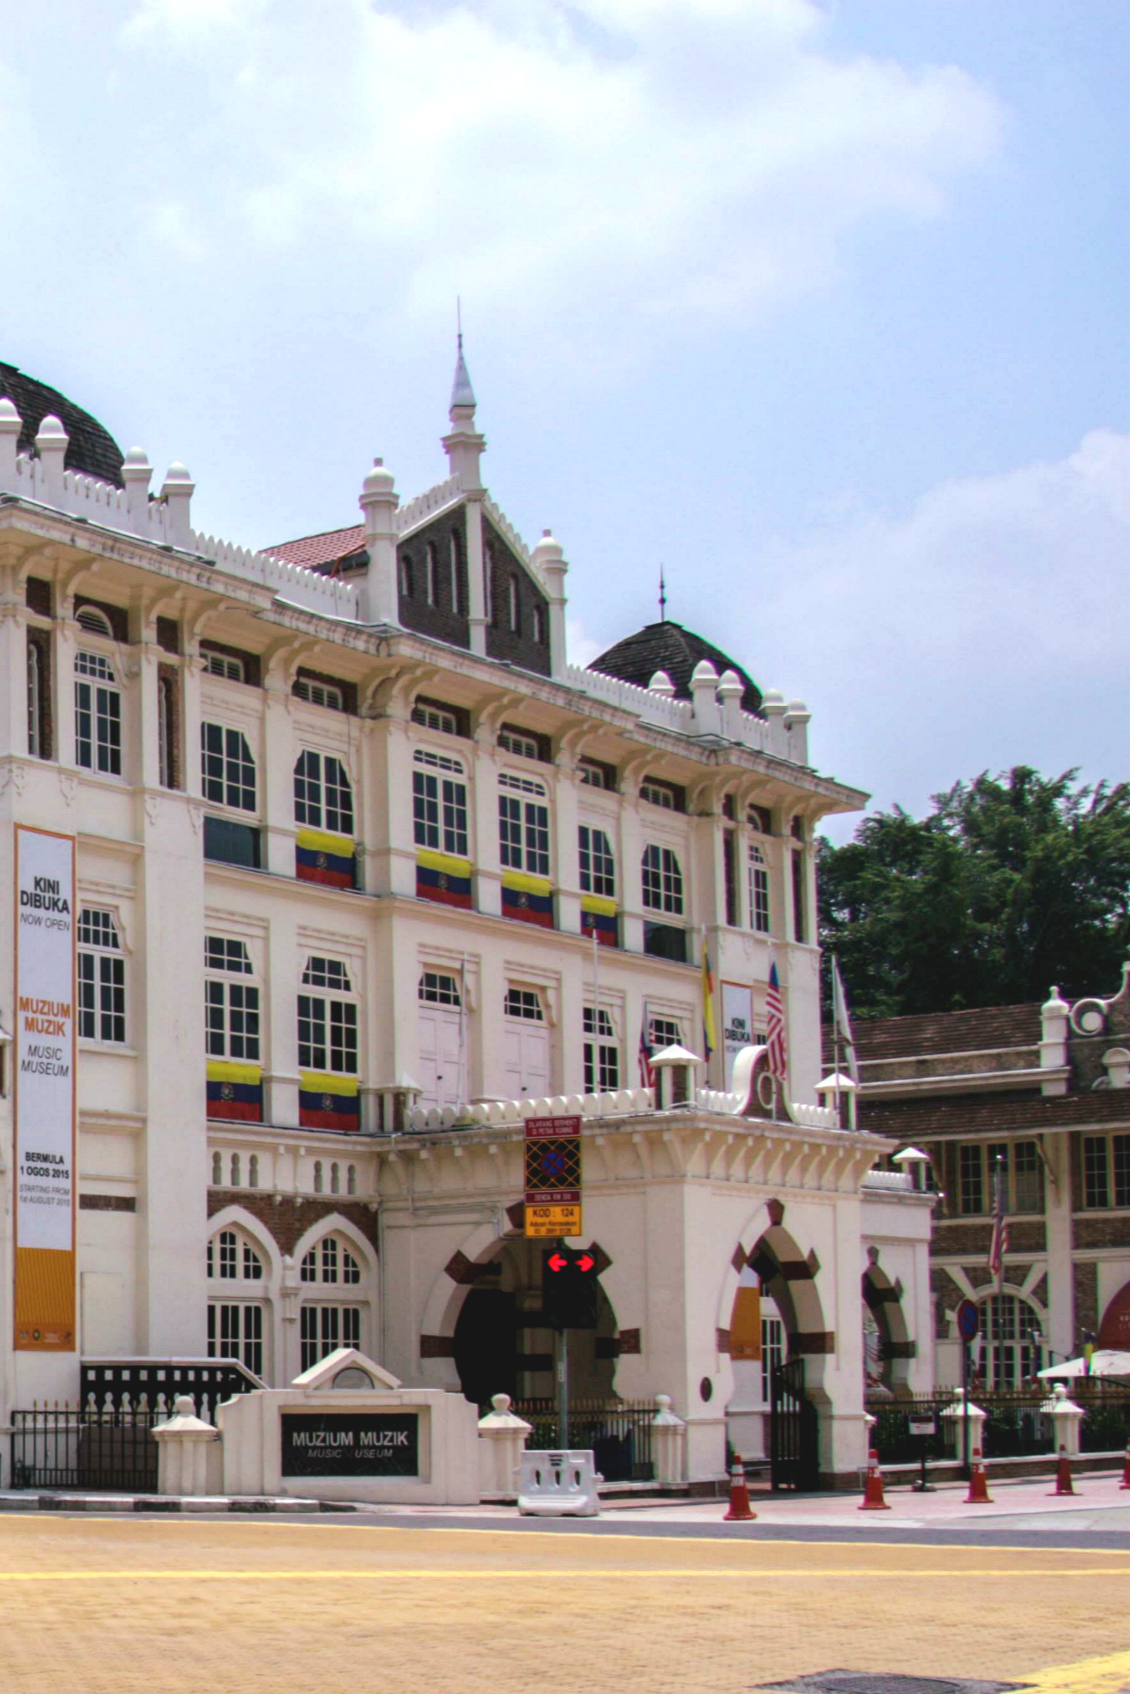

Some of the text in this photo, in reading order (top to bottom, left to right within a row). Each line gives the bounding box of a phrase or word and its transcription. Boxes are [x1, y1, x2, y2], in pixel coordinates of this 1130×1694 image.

[34, 876, 60, 895] KINI
[20, 890, 70, 915] DIBUKA
[20, 912, 70, 931] NOW OPEN
[19, 996, 71, 1019] MUZIUM
[24, 1016, 66, 1037] MUZIK
[731, 1017, 745, 1030] KINI
[724, 1028, 751, 1043] DIBUKA
[27, 1044, 62, 1061] MUSIC
[20, 1059, 69, 1077] MUSEUM
[25, 1151, 65, 1165] BERMULA
[26, 1166, 50, 1177] OGOS
[51, 1168, 70, 1179] 2015
[19, 1184, 70, 1196] STARTING FROM
[29, 1196, 55, 1205] AUGUST
[561, 1208, 574, 1217] 124
[292, 1431, 409, 1447] MUZIUM MUZIK
[307, 1449, 393, 1458] MUSIC USEUM
